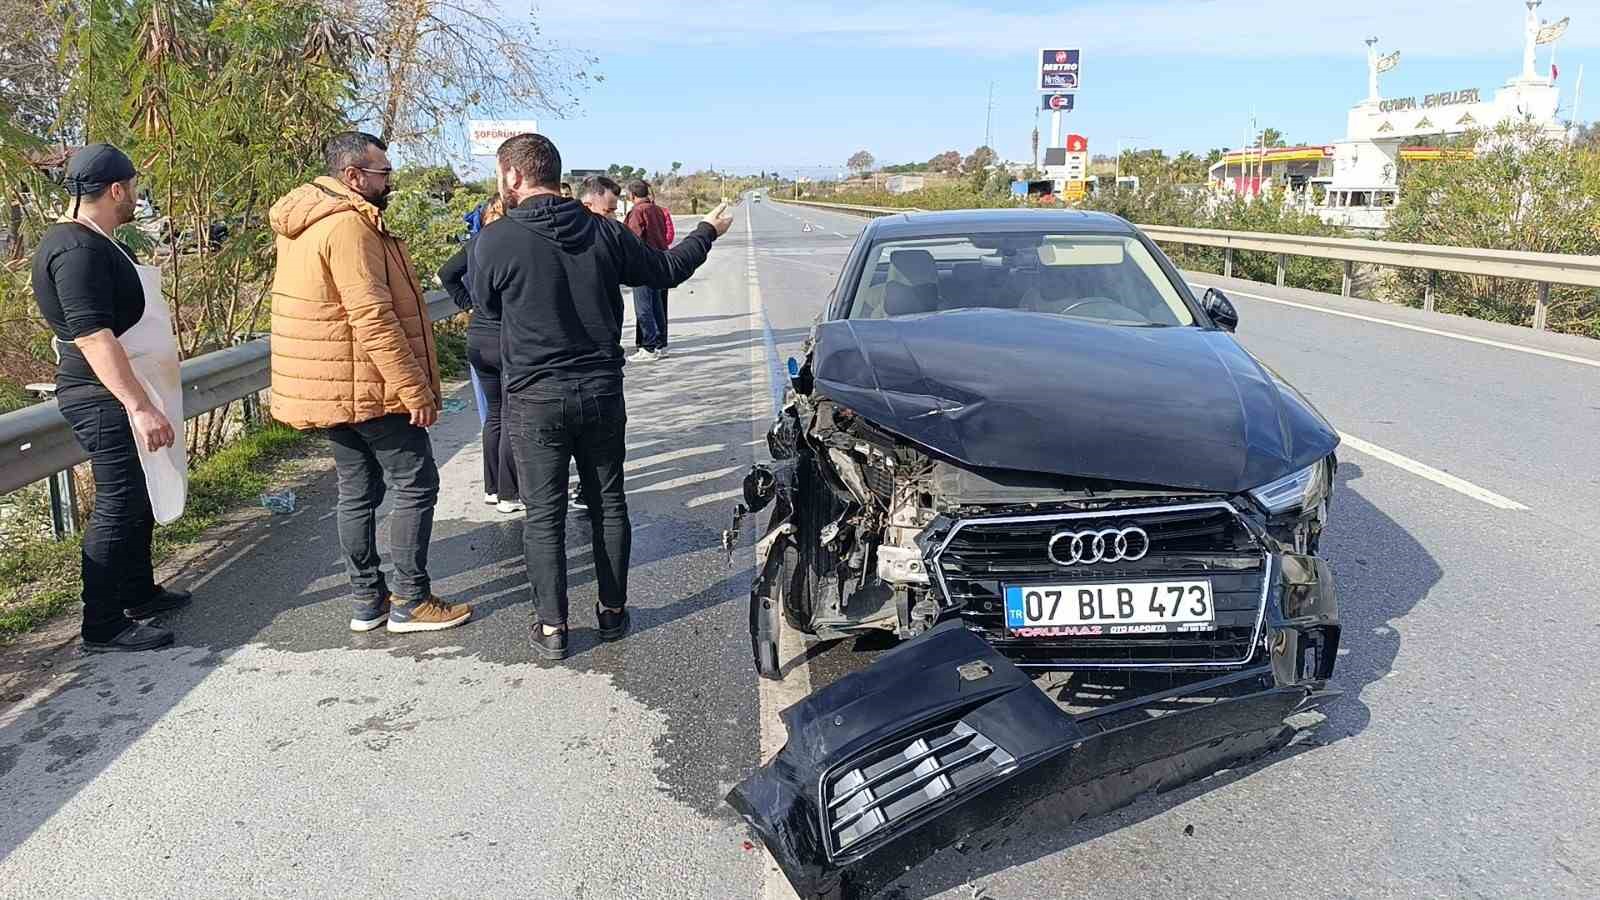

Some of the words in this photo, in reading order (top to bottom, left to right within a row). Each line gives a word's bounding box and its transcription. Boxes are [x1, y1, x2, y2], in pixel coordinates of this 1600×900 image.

[1043, 63, 1077, 71] METRO
[1379, 96, 1417, 112] OLYMPIA
[1025, 591, 1062, 621] 07
[1078, 588, 1134, 620] BLB
[1149, 585, 1207, 618] 473
[1009, 609, 1023, 619] TR
[1010, 625, 1103, 638] YORULMAZ
[1110, 626, 1127, 634] OTO
[1128, 624, 1167, 633] KAPORTA
